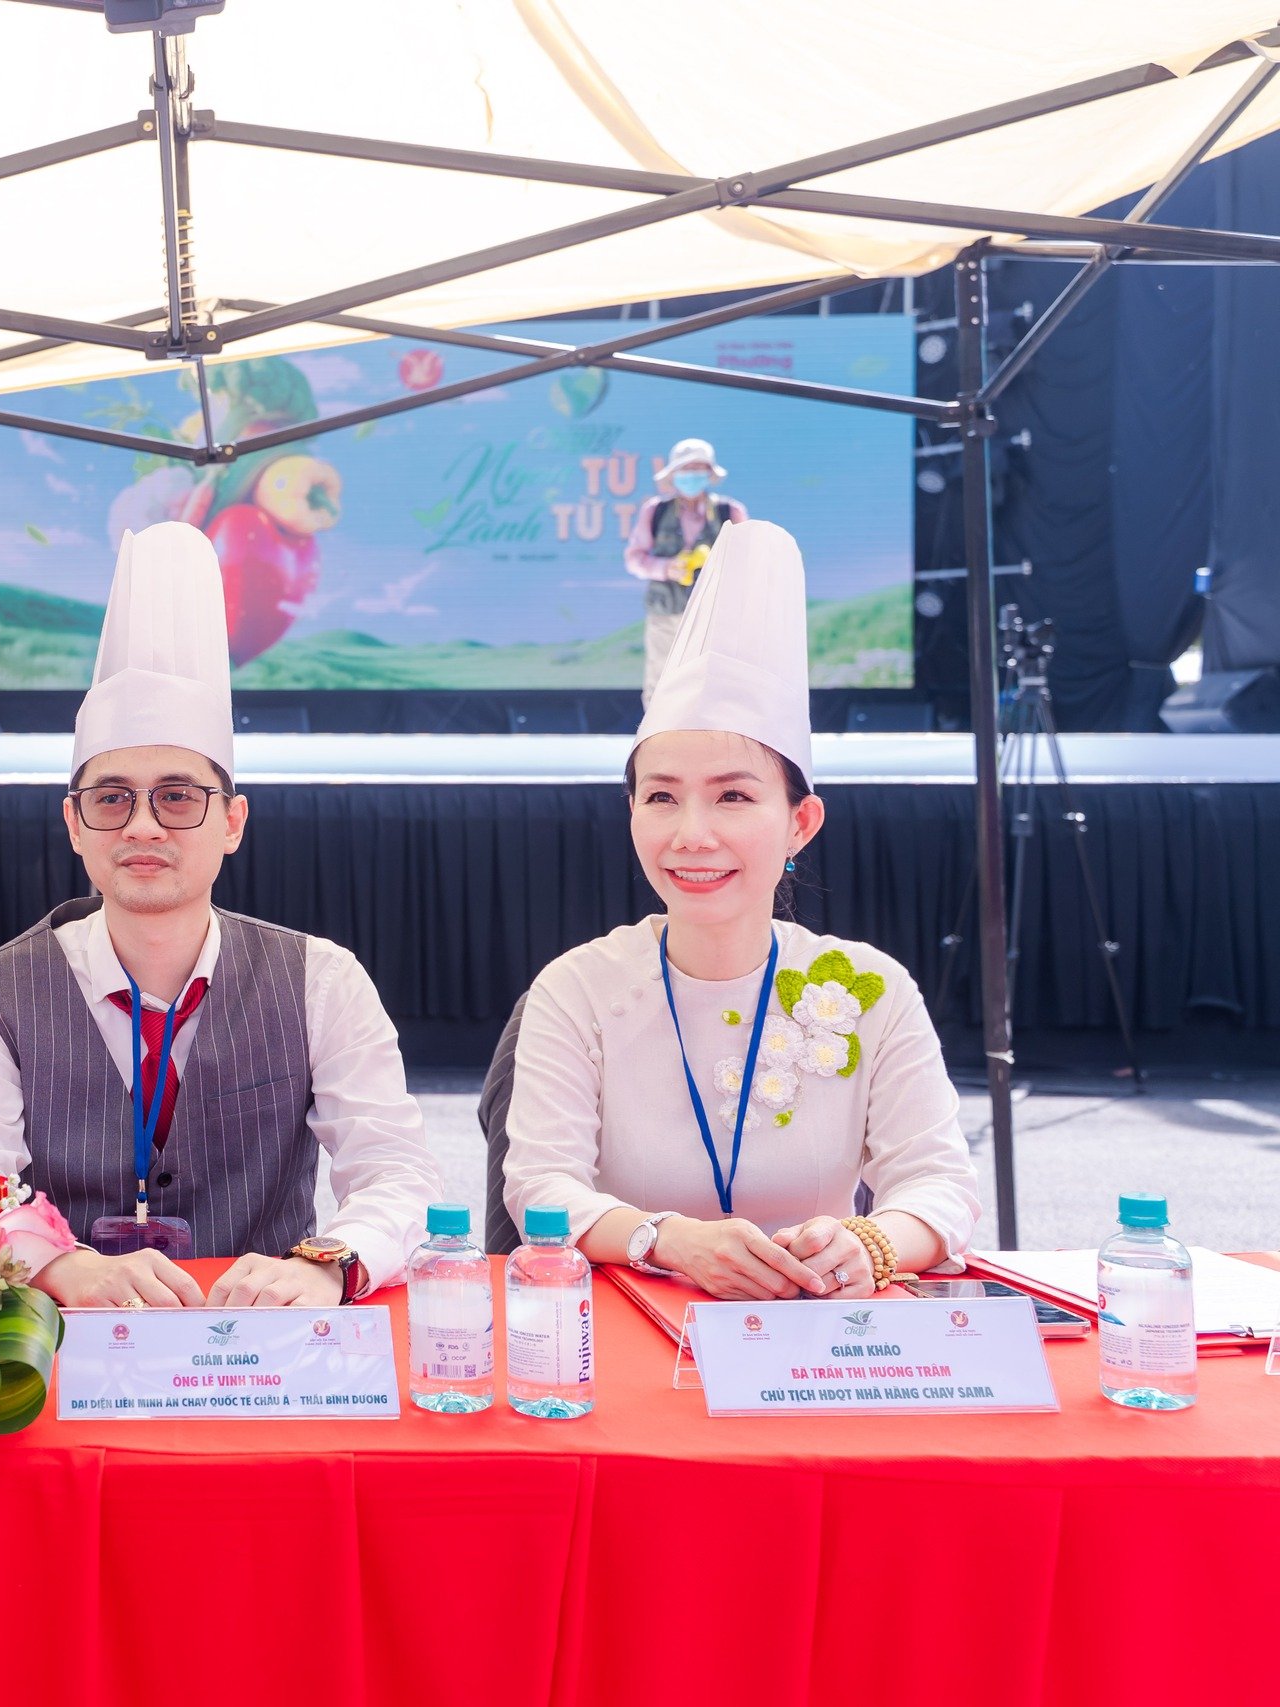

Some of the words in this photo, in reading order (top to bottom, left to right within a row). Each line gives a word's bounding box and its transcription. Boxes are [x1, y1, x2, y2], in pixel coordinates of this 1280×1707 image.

[578, 1320, 591, 1383] Fujiwa
[831, 1344, 864, 1357] GIÁM
[866, 1342, 902, 1356] KHẢO
[192, 1352, 223, 1366] GIÁM
[226, 1352, 260, 1366] KHẢO
[172, 1374, 198, 1387] ÔNG
[202, 1373, 214, 1387] LÊ
[249, 1374, 282, 1386] THAO
[791, 1366, 810, 1379] BÀ
[810, 1364, 844, 1379] TRẦN
[846, 1367, 867, 1380] THỊ
[868, 1365, 914, 1378] HƯƠNG
[72, 1400, 88, 1410] ĐẠI
[90, 1398, 112, 1410] DIỆN
[115, 1397, 135, 1408] LIÊN
[138, 1398, 163, 1408] MINH
[182, 1397, 207, 1408] CHAY
[210, 1394, 238, 1408] QUỐC
[240, 1394, 251, 1406] TẾ
[254, 1394, 280, 1406] CHÂU
[300, 1394, 323, 1405] THÁI
[326, 1394, 349, 1405] BÌNH
[352, 1394, 388, 1404] DƯƠNG
[760, 1387, 786, 1402] CHỦ
[788, 1389, 816, 1402] TỊCH
[818, 1389, 852, 1401] HĐQT
[855, 1386, 882, 1400] NHÀ
[884, 1386, 920, 1400] HÀNG
[922, 1387, 954, 1398] CHAY
[958, 1386, 994, 1398] SAMA
